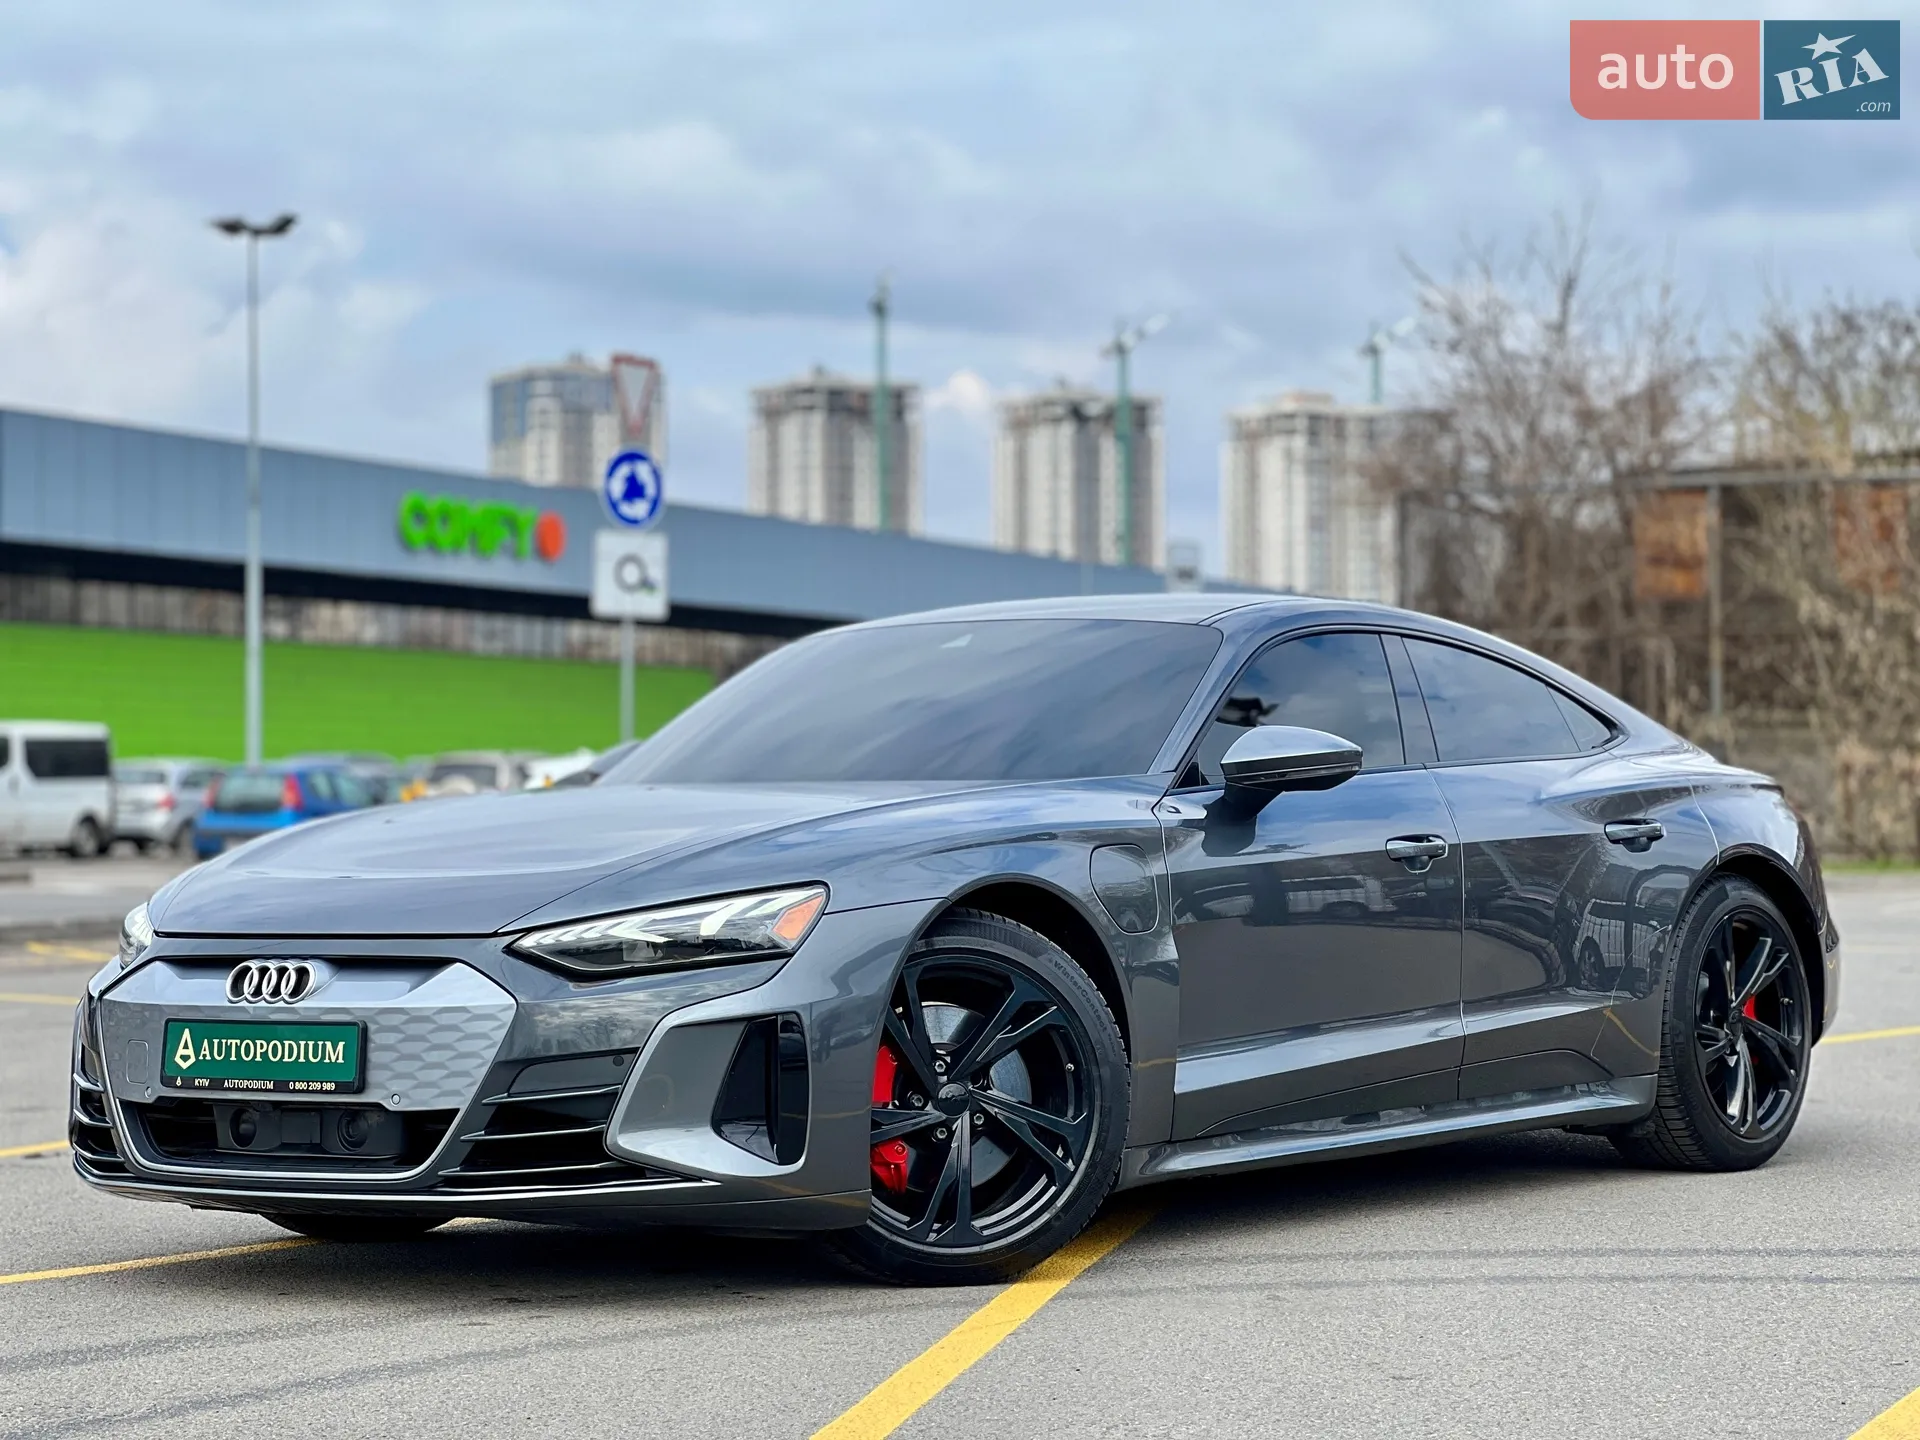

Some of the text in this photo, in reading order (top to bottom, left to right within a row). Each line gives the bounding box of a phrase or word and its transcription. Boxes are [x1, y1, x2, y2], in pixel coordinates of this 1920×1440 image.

[400, 489, 538, 561] COMFY
[198, 1038, 346, 1064] AUTOPODIUM
[194, 1078, 336, 1091] KYIV AUTOPODIUM 0 800 209 989
